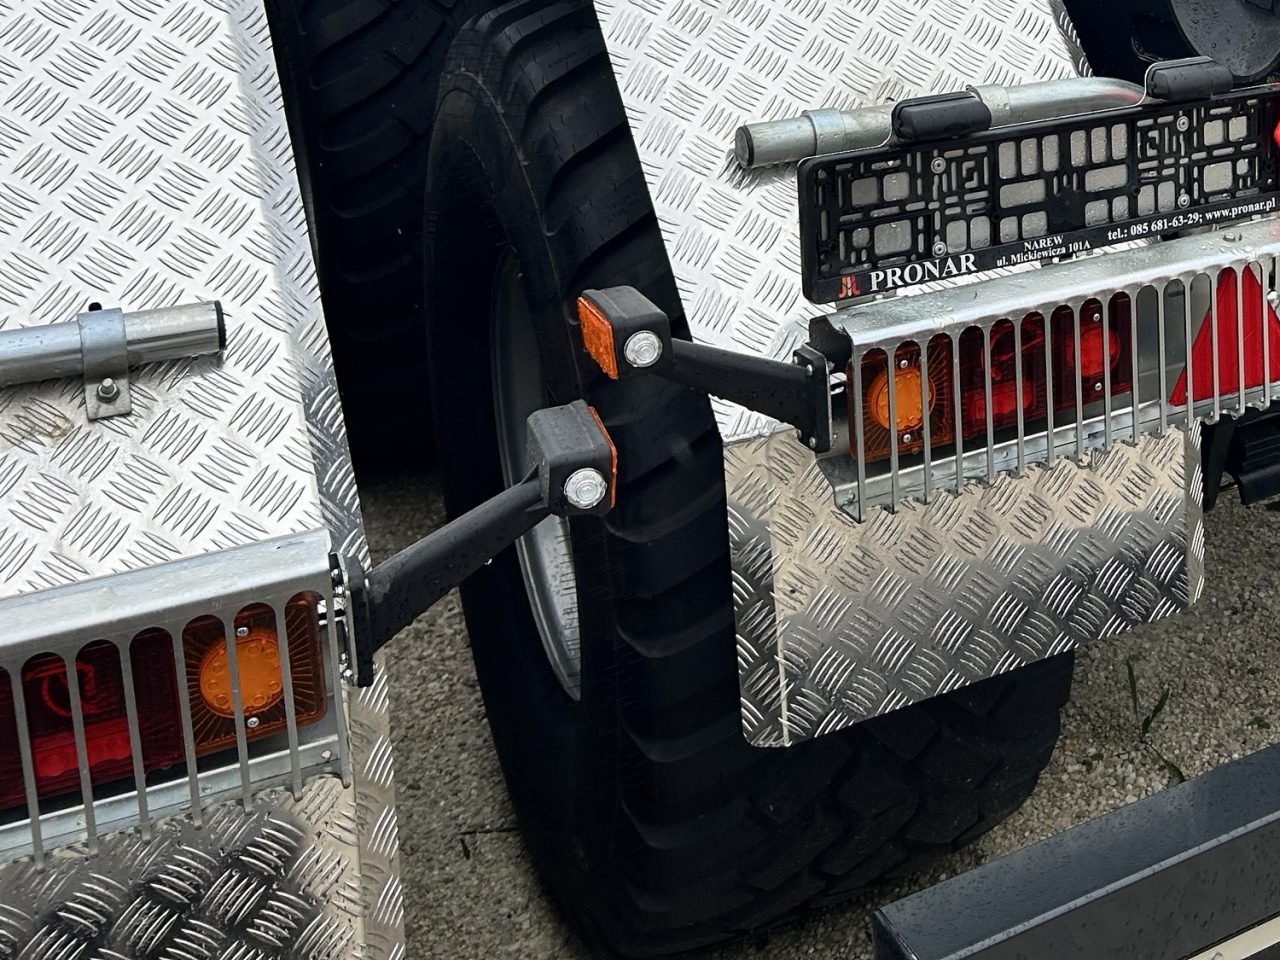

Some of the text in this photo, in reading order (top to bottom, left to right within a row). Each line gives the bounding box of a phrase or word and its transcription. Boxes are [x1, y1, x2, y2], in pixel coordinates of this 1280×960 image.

[1107, 197, 1276, 241] tel.: 085 681-63-29; www.pronar.pl
[996, 240, 1091, 267] ul. Mickiewicza 101A
[1024, 235, 1064, 252] NAREW
[868, 252, 978, 292] PRONAR
